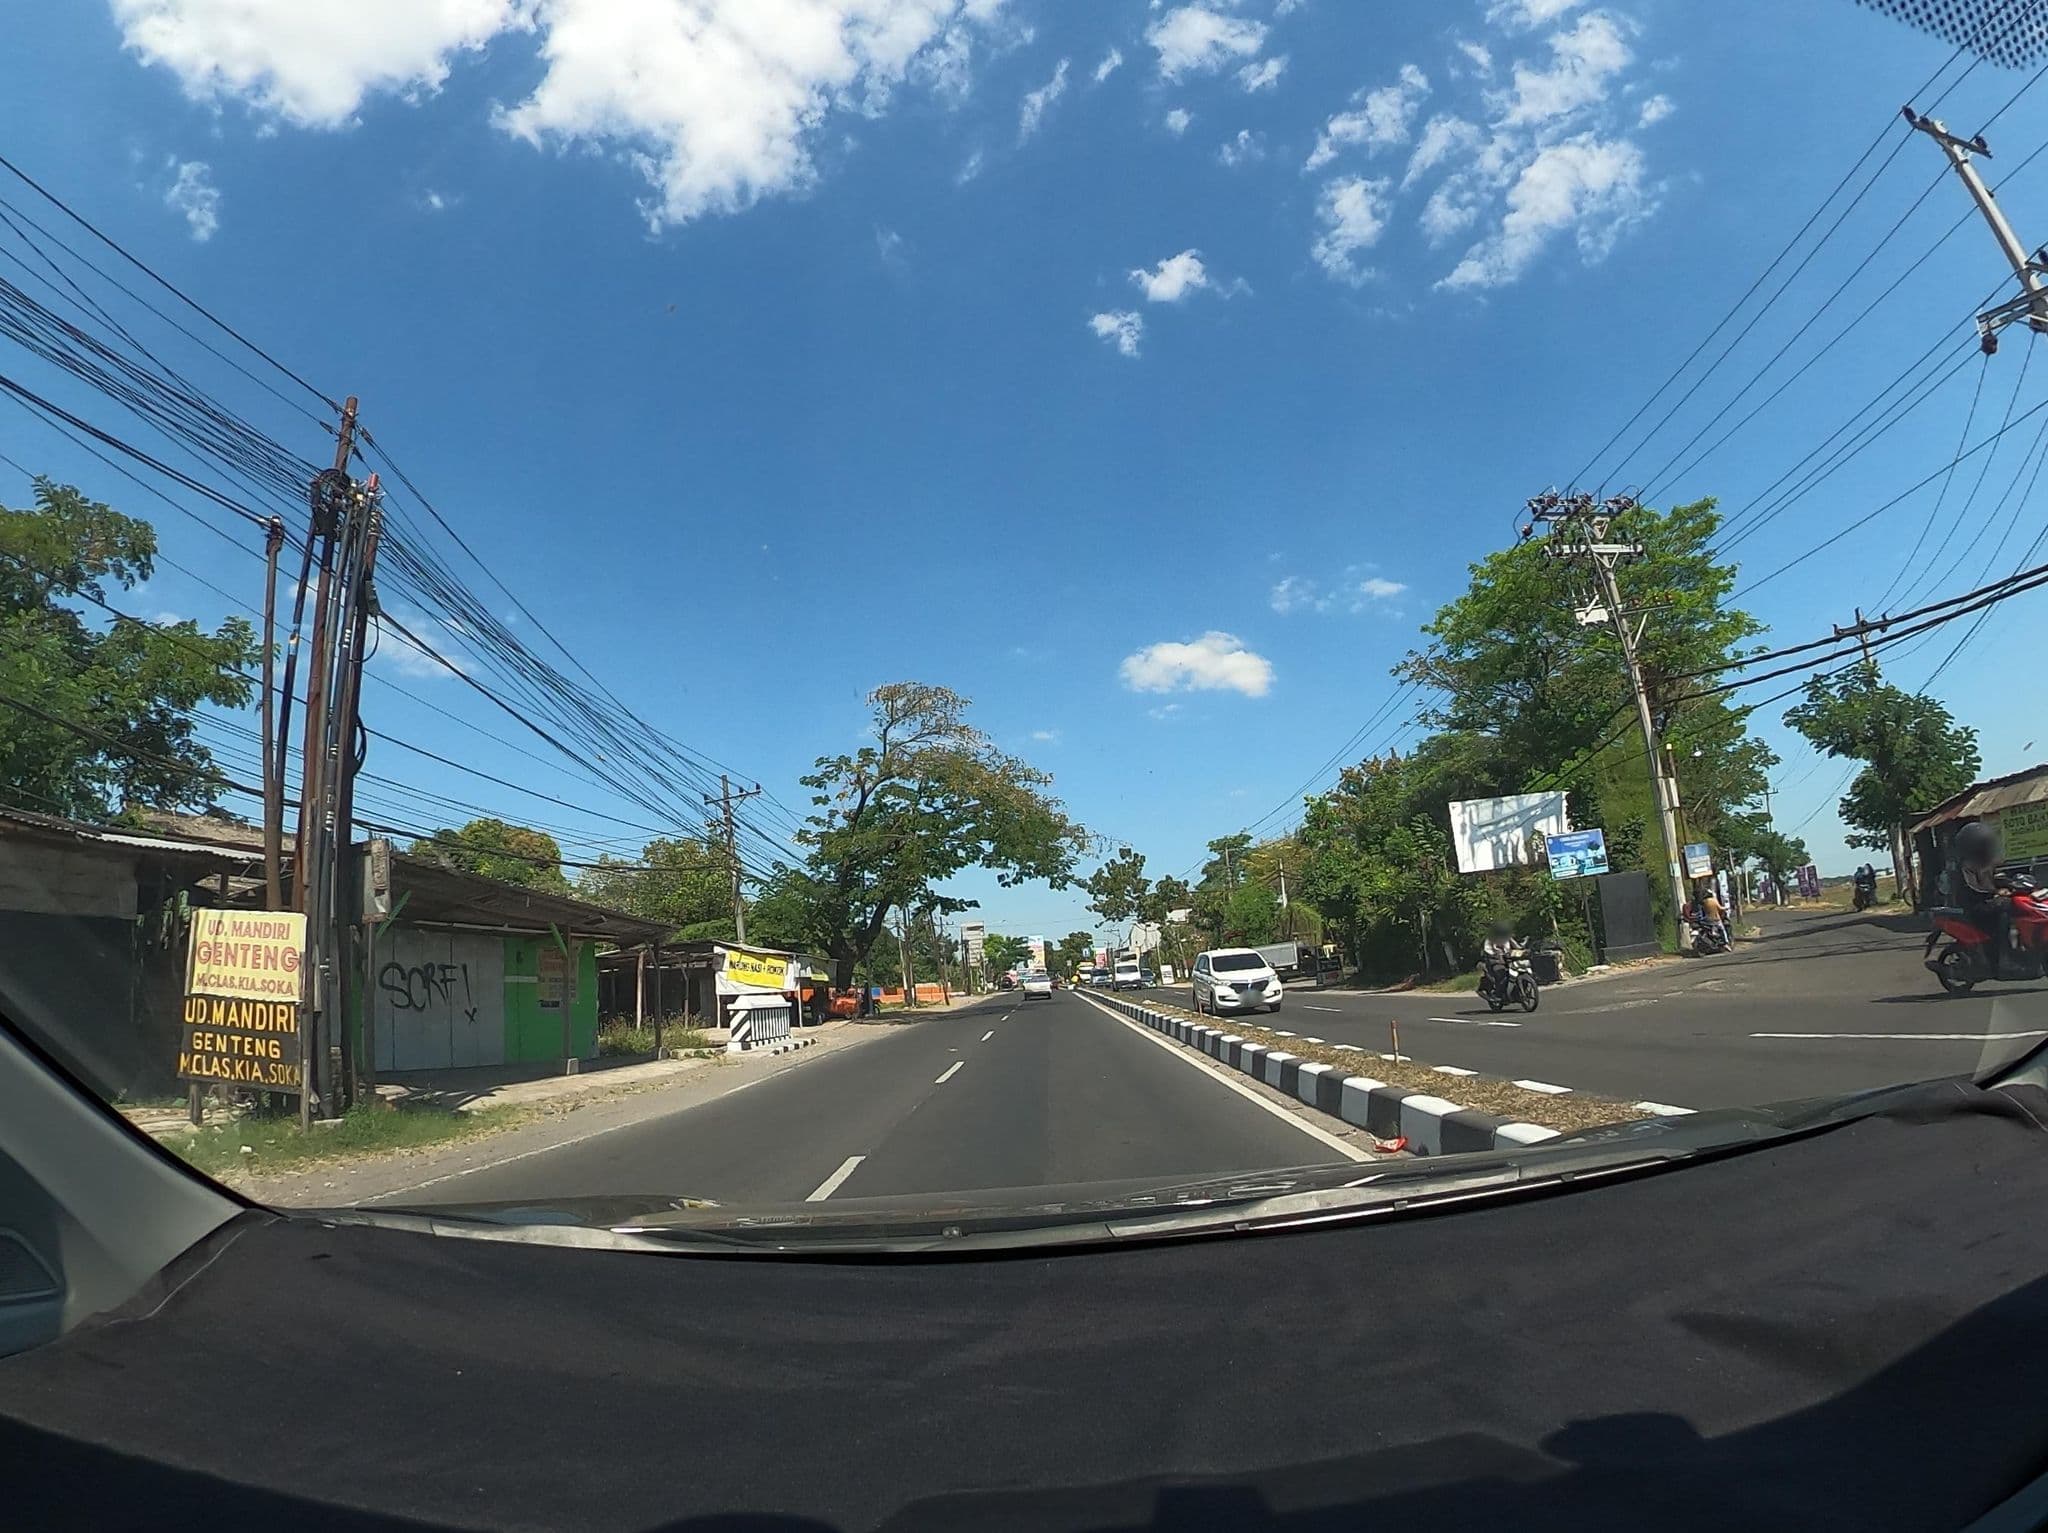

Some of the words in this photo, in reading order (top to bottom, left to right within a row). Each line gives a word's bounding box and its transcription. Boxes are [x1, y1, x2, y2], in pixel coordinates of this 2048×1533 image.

[231, 921, 291, 941] MANDIRI
[197, 940, 300, 972] GENTENG
[192, 1032, 281, 1059] GENTENG
